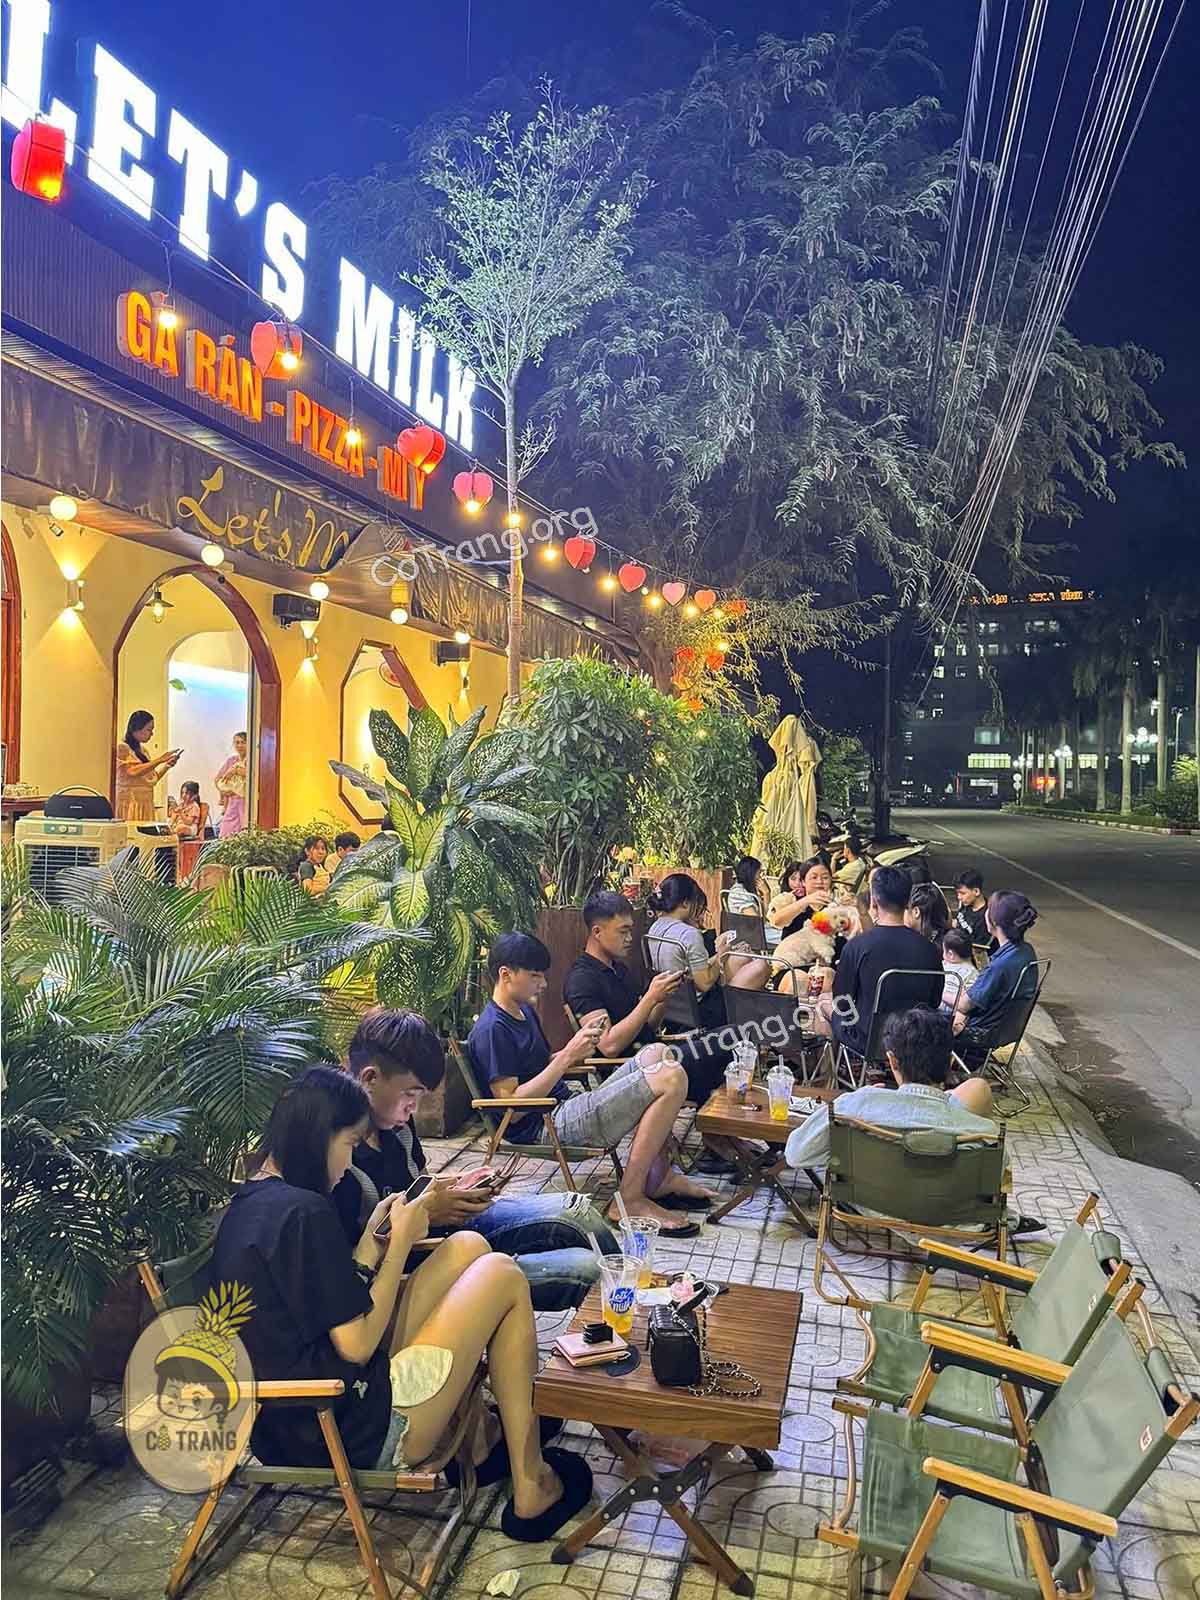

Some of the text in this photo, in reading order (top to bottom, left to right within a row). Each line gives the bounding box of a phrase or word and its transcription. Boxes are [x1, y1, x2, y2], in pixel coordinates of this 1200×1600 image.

[0, 0, 477, 453] LET'S MILK
[186, 329, 264, 423] RÁN
[287, 390, 365, 479] PIZZA
